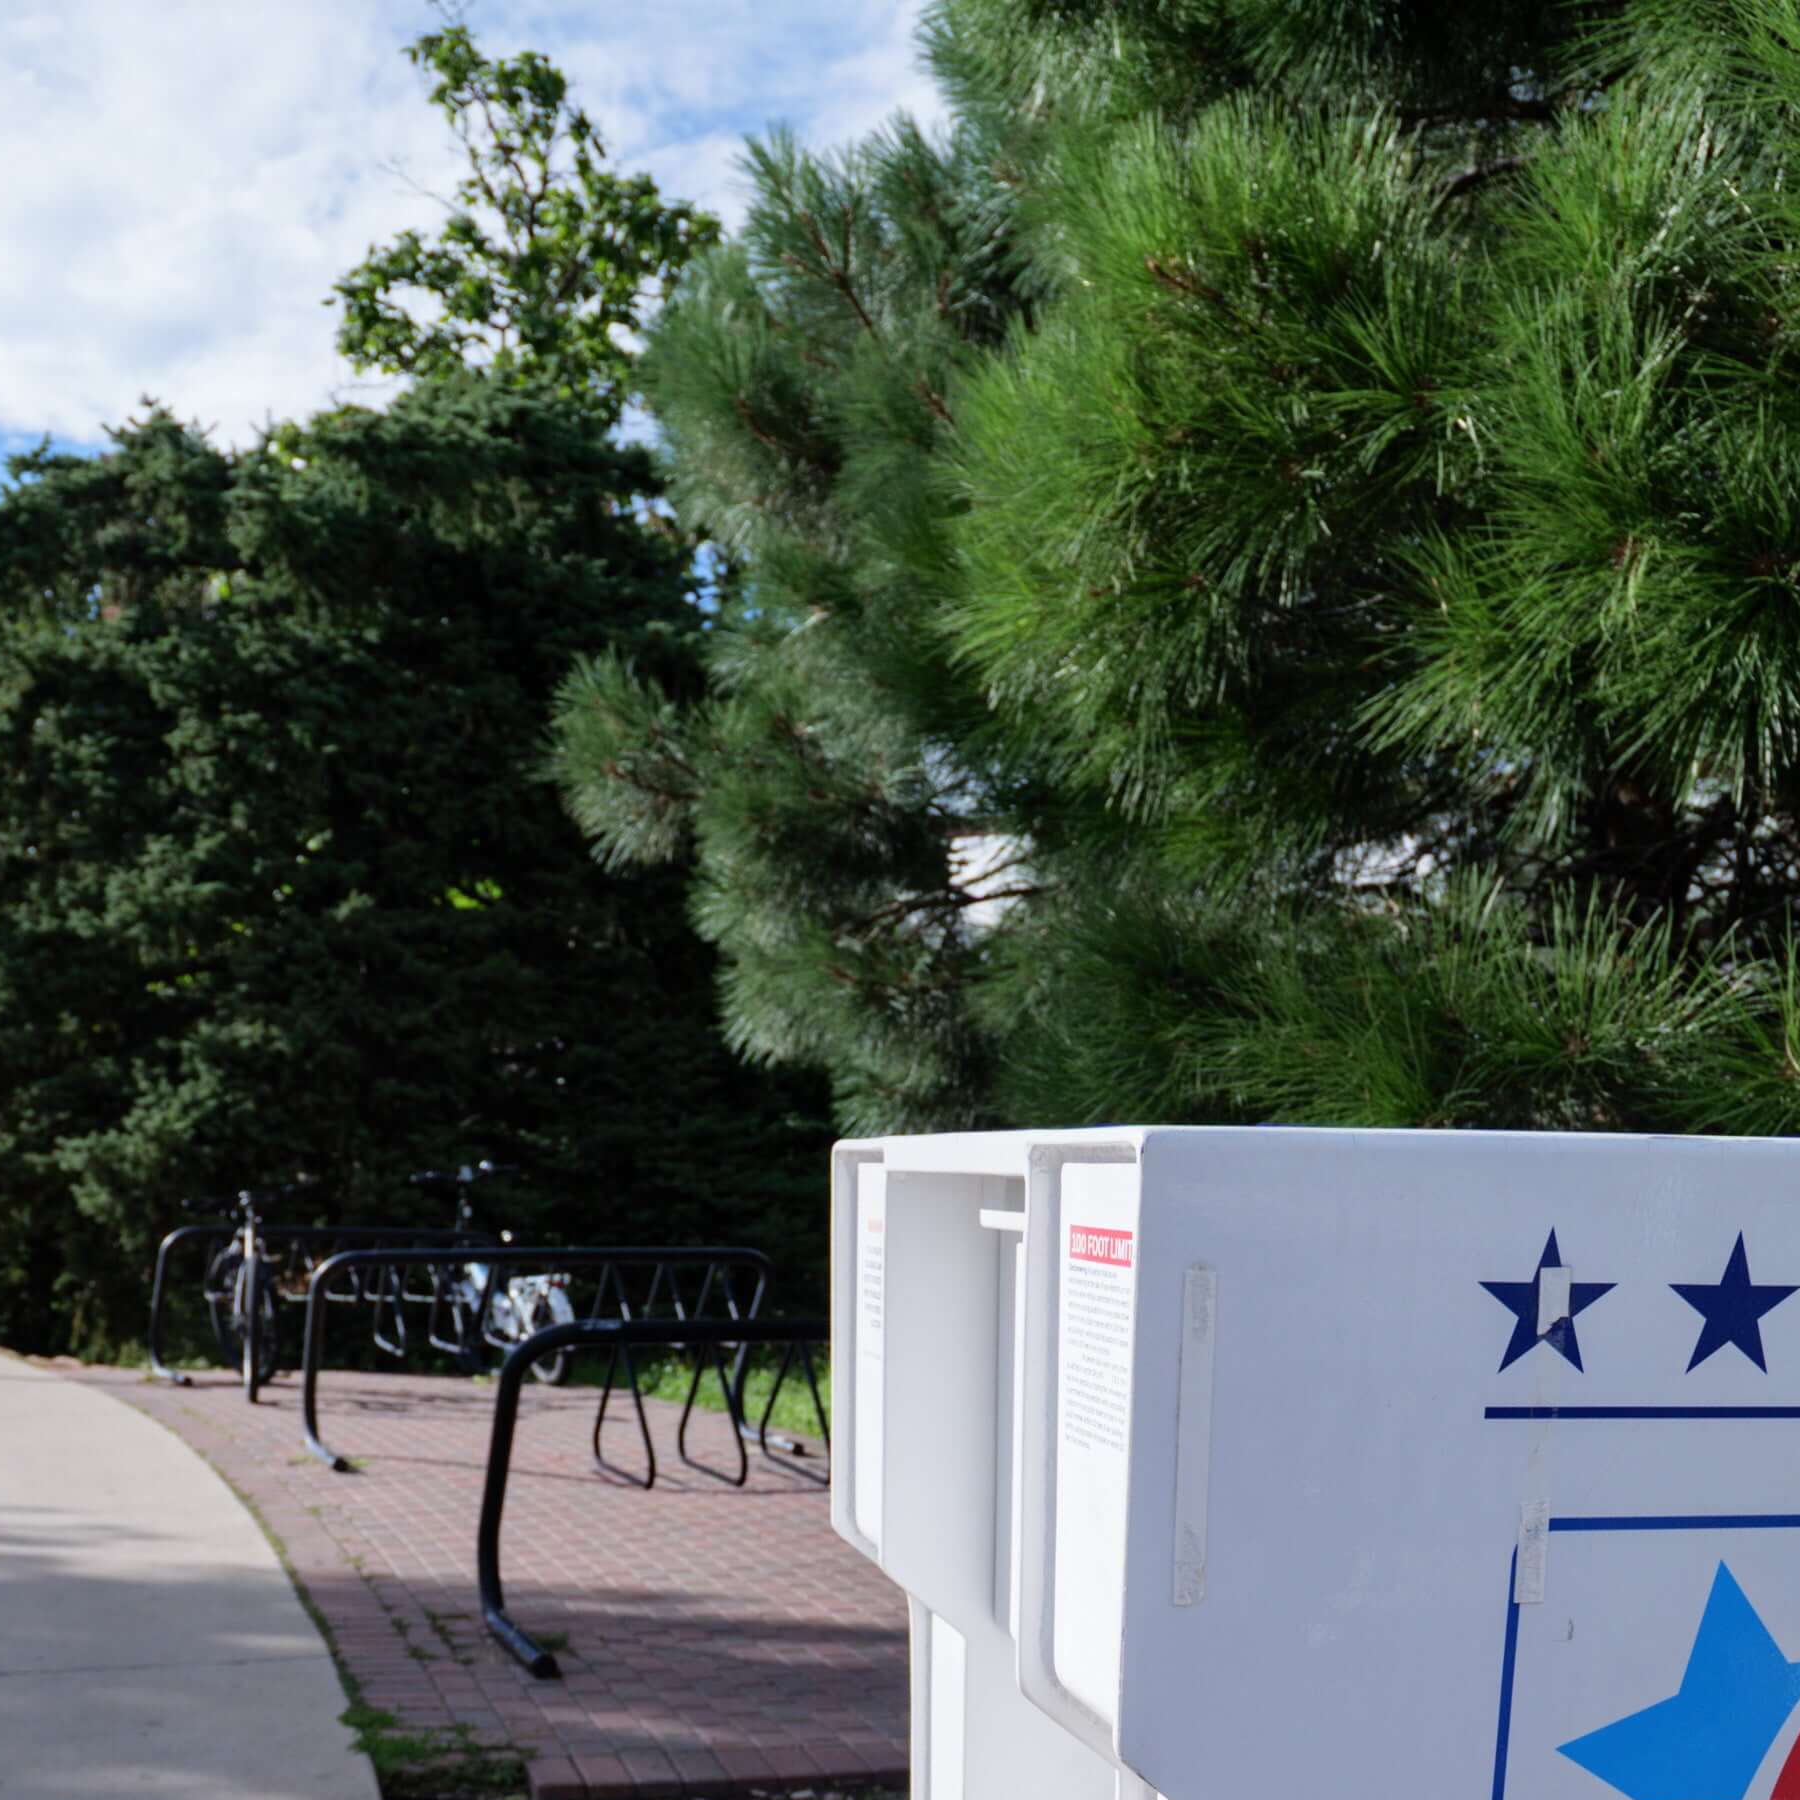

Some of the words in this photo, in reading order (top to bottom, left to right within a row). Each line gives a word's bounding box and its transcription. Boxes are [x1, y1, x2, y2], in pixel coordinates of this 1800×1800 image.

[1071, 1231, 1087, 1254] 100
[1087, 1233, 1110, 1259] FOOT
[1110, 1236, 1133, 1263] LIMIT
